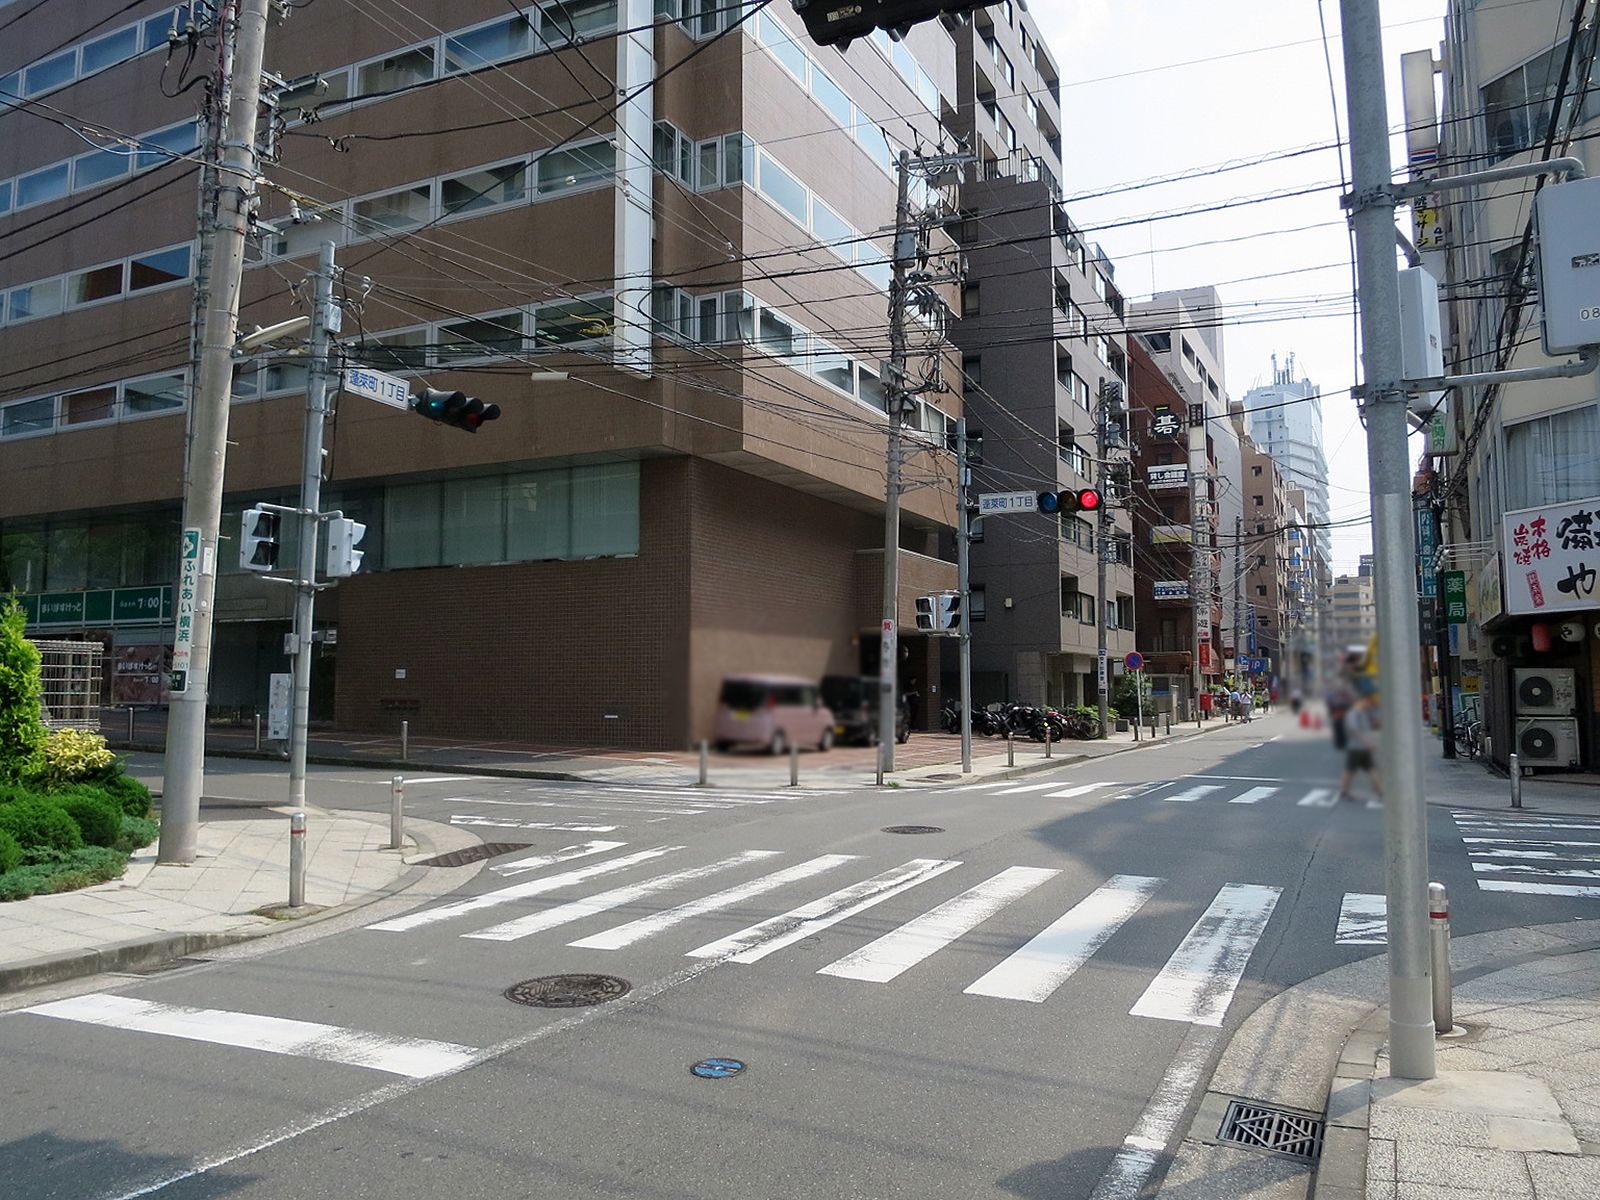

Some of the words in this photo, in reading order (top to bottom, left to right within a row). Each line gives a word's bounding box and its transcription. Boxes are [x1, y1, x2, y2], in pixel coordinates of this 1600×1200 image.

[1154, 415, 1179, 435] 碁
[1530, 515, 1551, 559] 本格
[137, 596, 160, 609] 7:00
[178, 561, 196, 642] ふれあい横浜
[1446, 577, 1465, 617] 薬局
